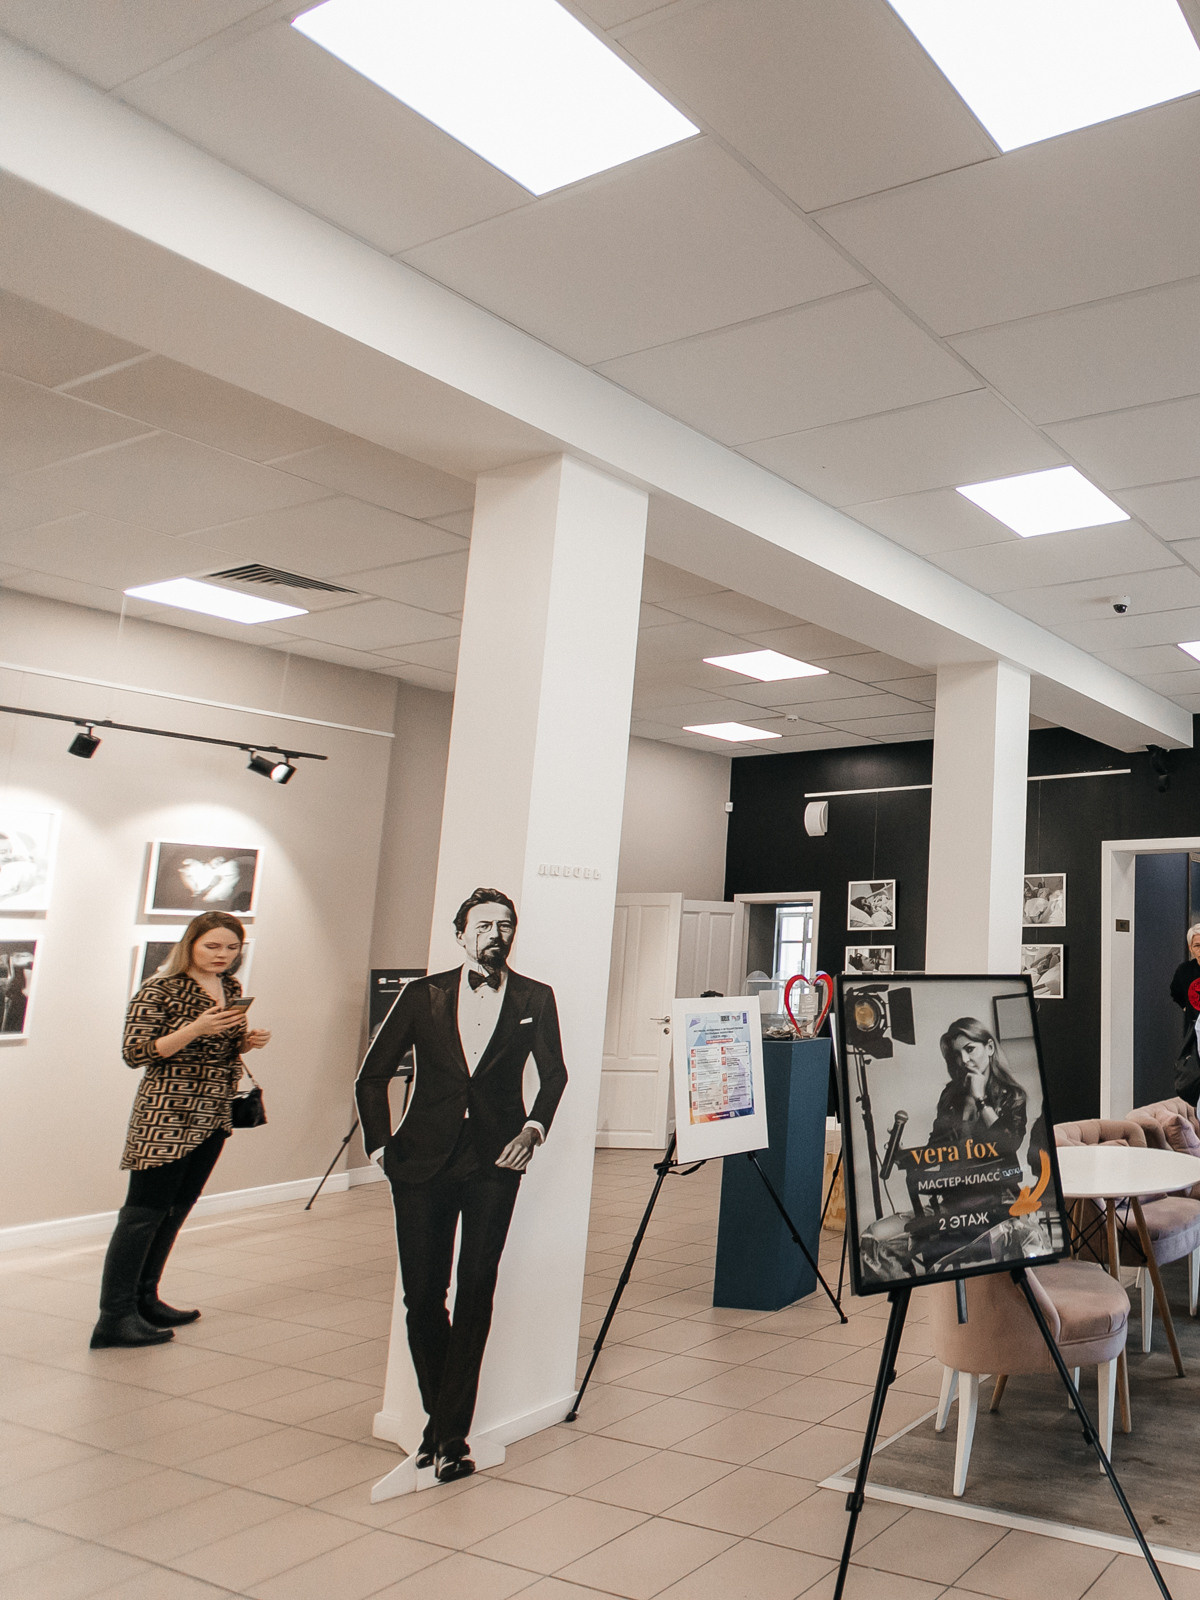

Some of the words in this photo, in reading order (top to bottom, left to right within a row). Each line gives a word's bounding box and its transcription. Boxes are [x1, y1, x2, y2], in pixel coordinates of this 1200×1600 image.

[911, 1144, 960, 1166] vera
[965, 1138, 999, 1160] fox
[917, 1171, 1001, 1191] МАСТЕР-КЛАСС
[938, 1216, 947, 1231] 2
[949, 1211, 990, 1229] ЭТАЖ
